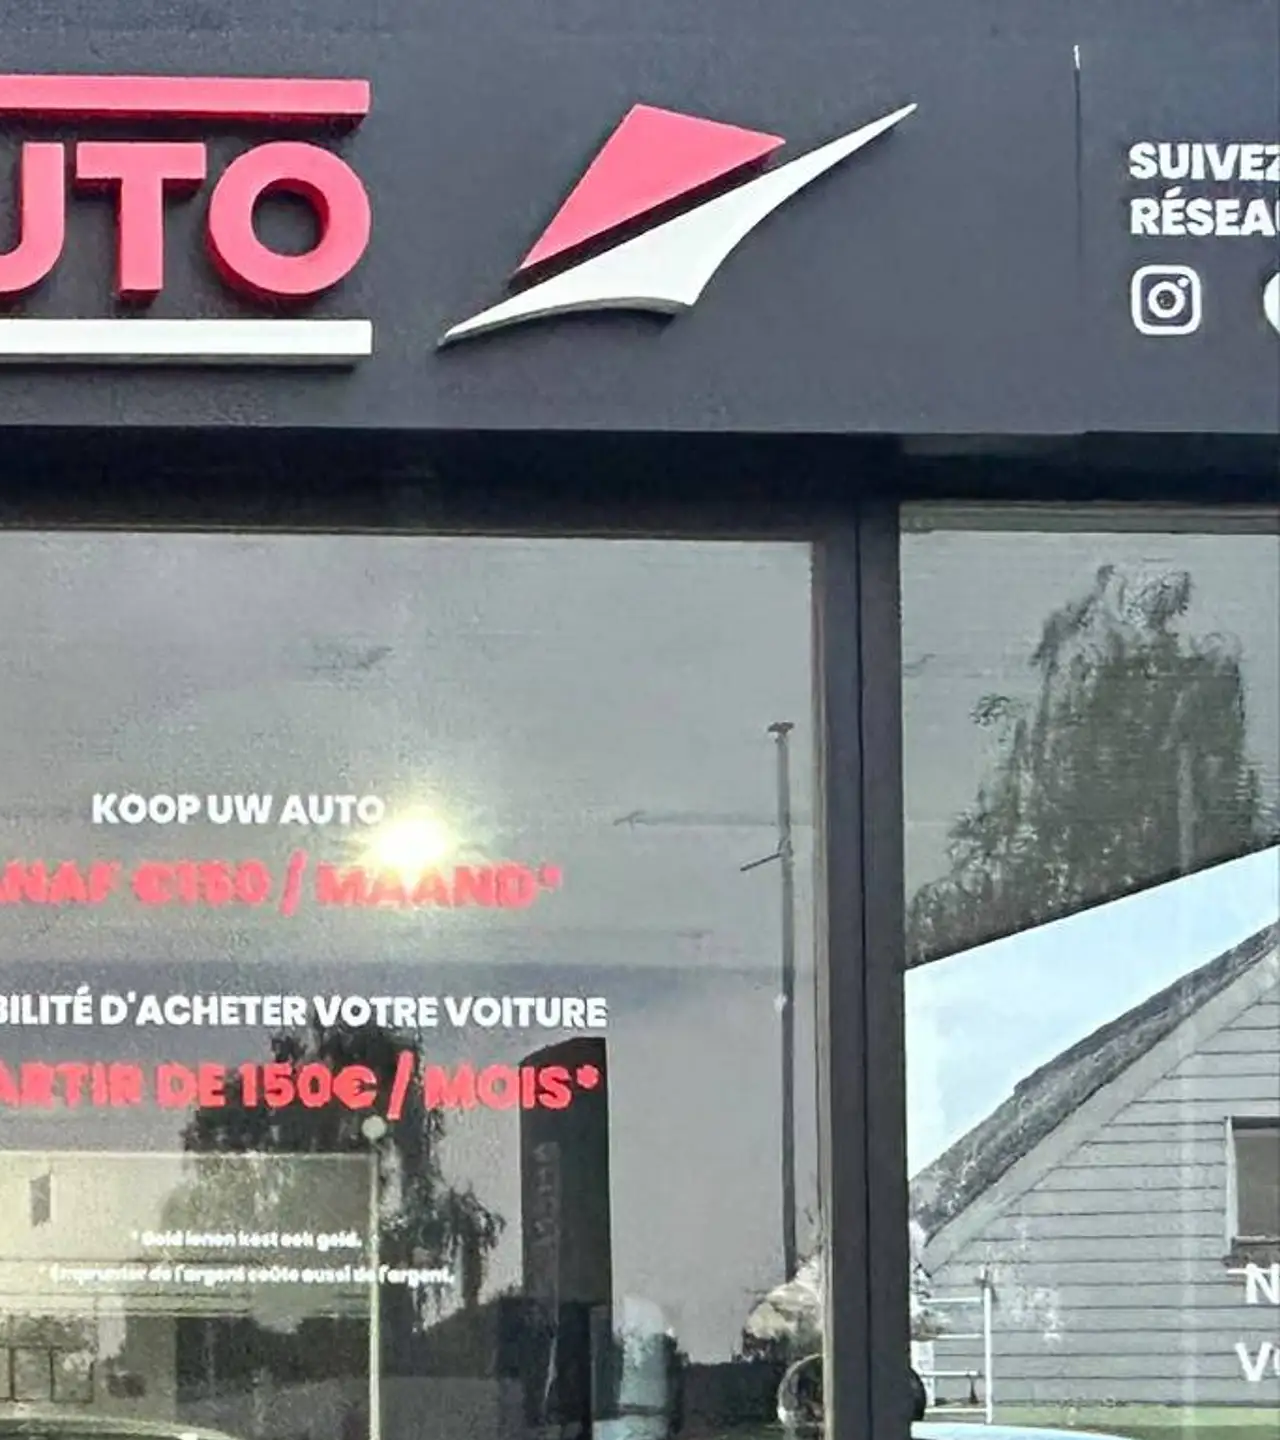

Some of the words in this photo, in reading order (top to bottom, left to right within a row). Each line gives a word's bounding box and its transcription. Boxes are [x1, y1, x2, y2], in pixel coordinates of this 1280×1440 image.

[1130, 186, 1280, 236] RÉSEA
[92, 793, 201, 826] KOOP
[207, 794, 272, 826] UW
[278, 794, 386, 826] AUTO
[100, 992, 307, 1028] D'ACHETER
[315, 996, 438, 1028] VOTRE
[443, 996, 609, 1029] VOITURE
[156, 1062, 226, 1108] DE
[236, 1062, 379, 1109] 150€
